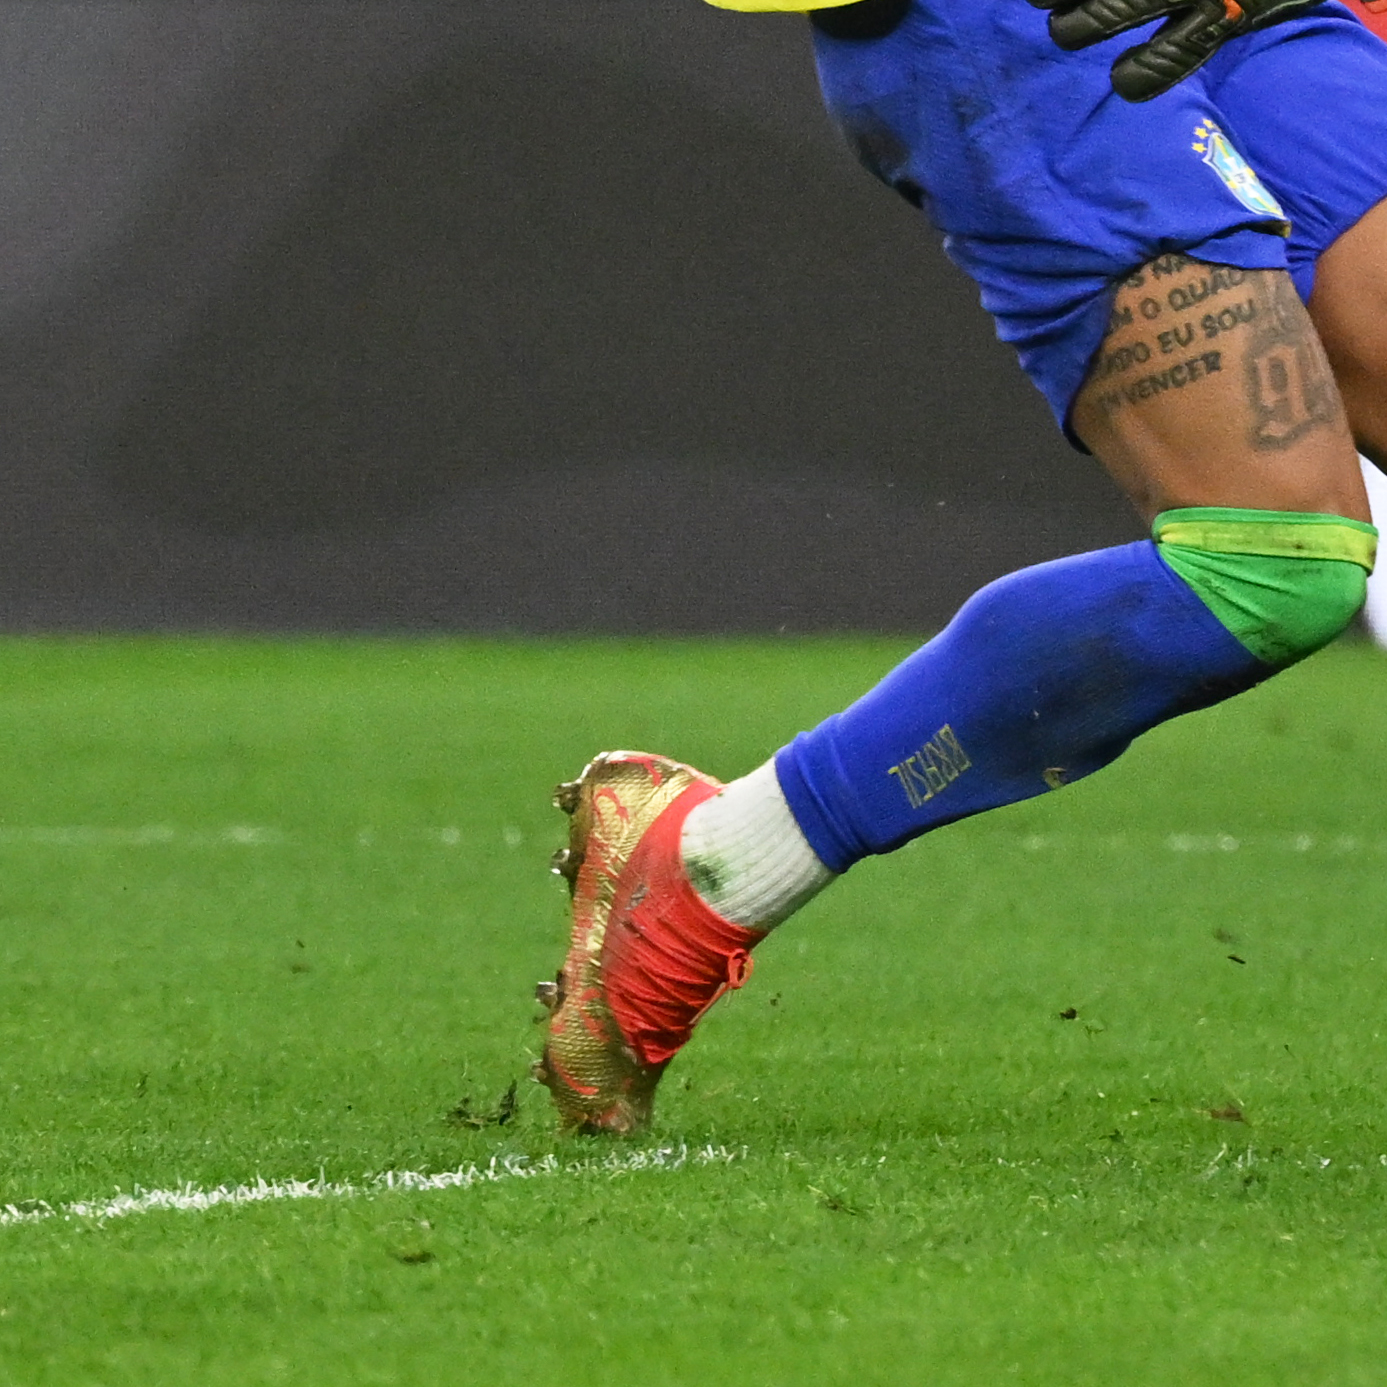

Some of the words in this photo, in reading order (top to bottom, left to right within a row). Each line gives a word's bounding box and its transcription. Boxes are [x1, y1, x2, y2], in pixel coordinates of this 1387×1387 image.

[1157, 322, 1194, 353] EU
[1201, 298, 1256, 338] SOU
[1122, 350, 1222, 404] VENCER
